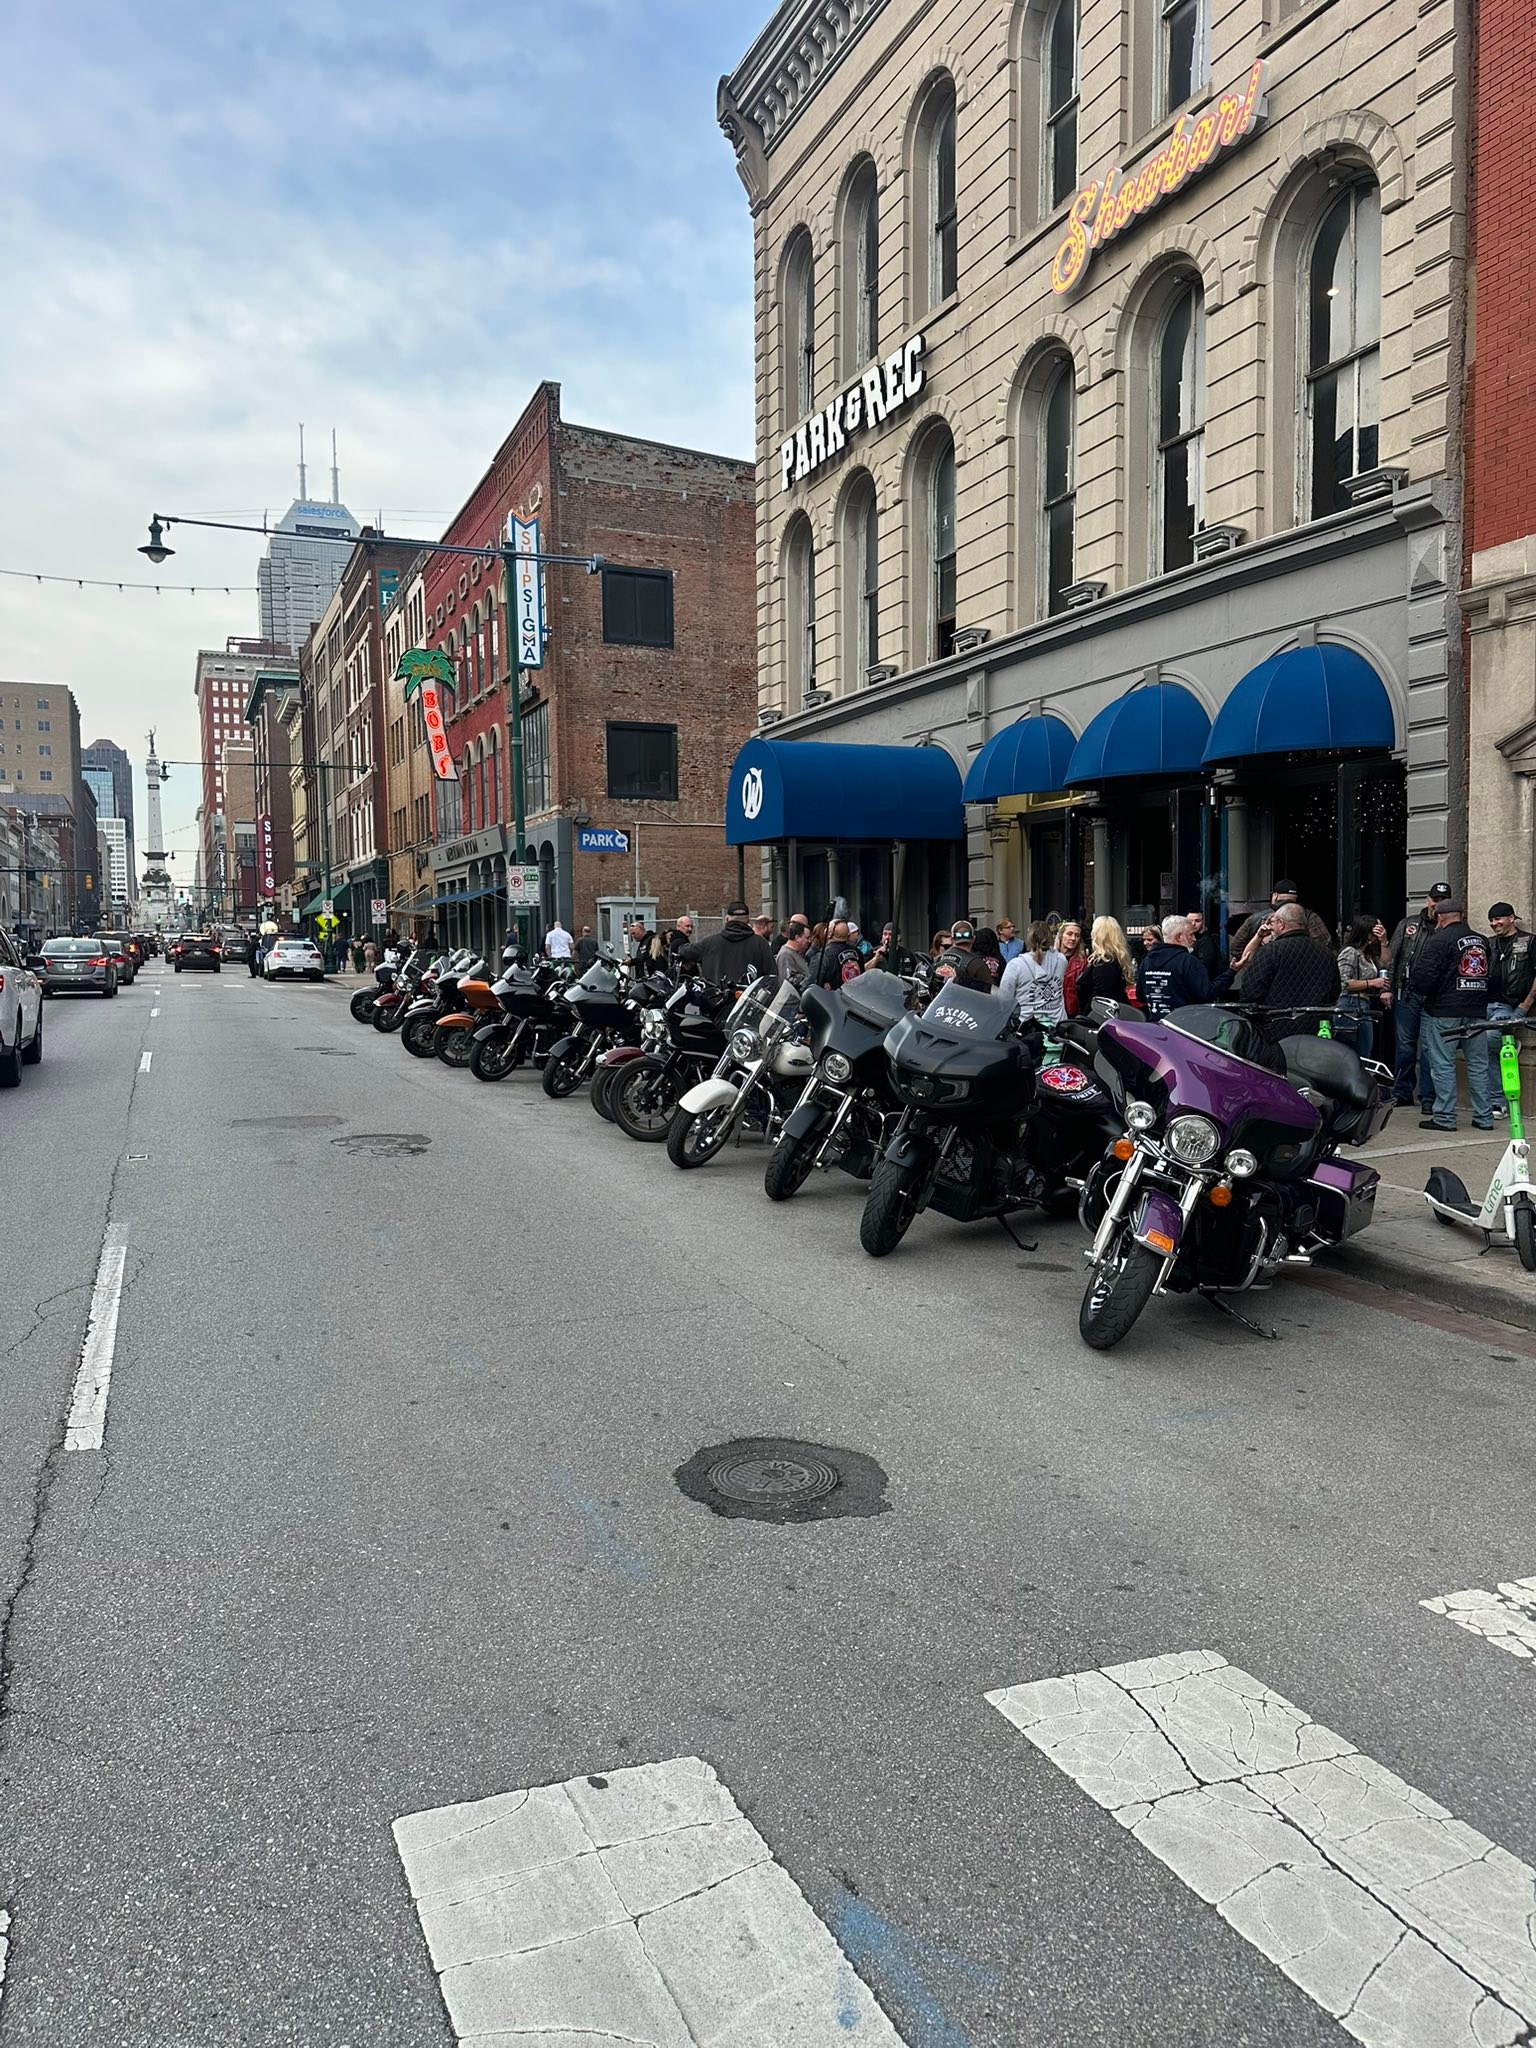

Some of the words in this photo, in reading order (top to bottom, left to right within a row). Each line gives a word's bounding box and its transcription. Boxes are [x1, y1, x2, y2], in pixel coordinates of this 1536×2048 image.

[295, 505, 347, 518] salesforce
[582, 833, 614, 847] PARK
[934, 1005, 978, 1030] Axemen
